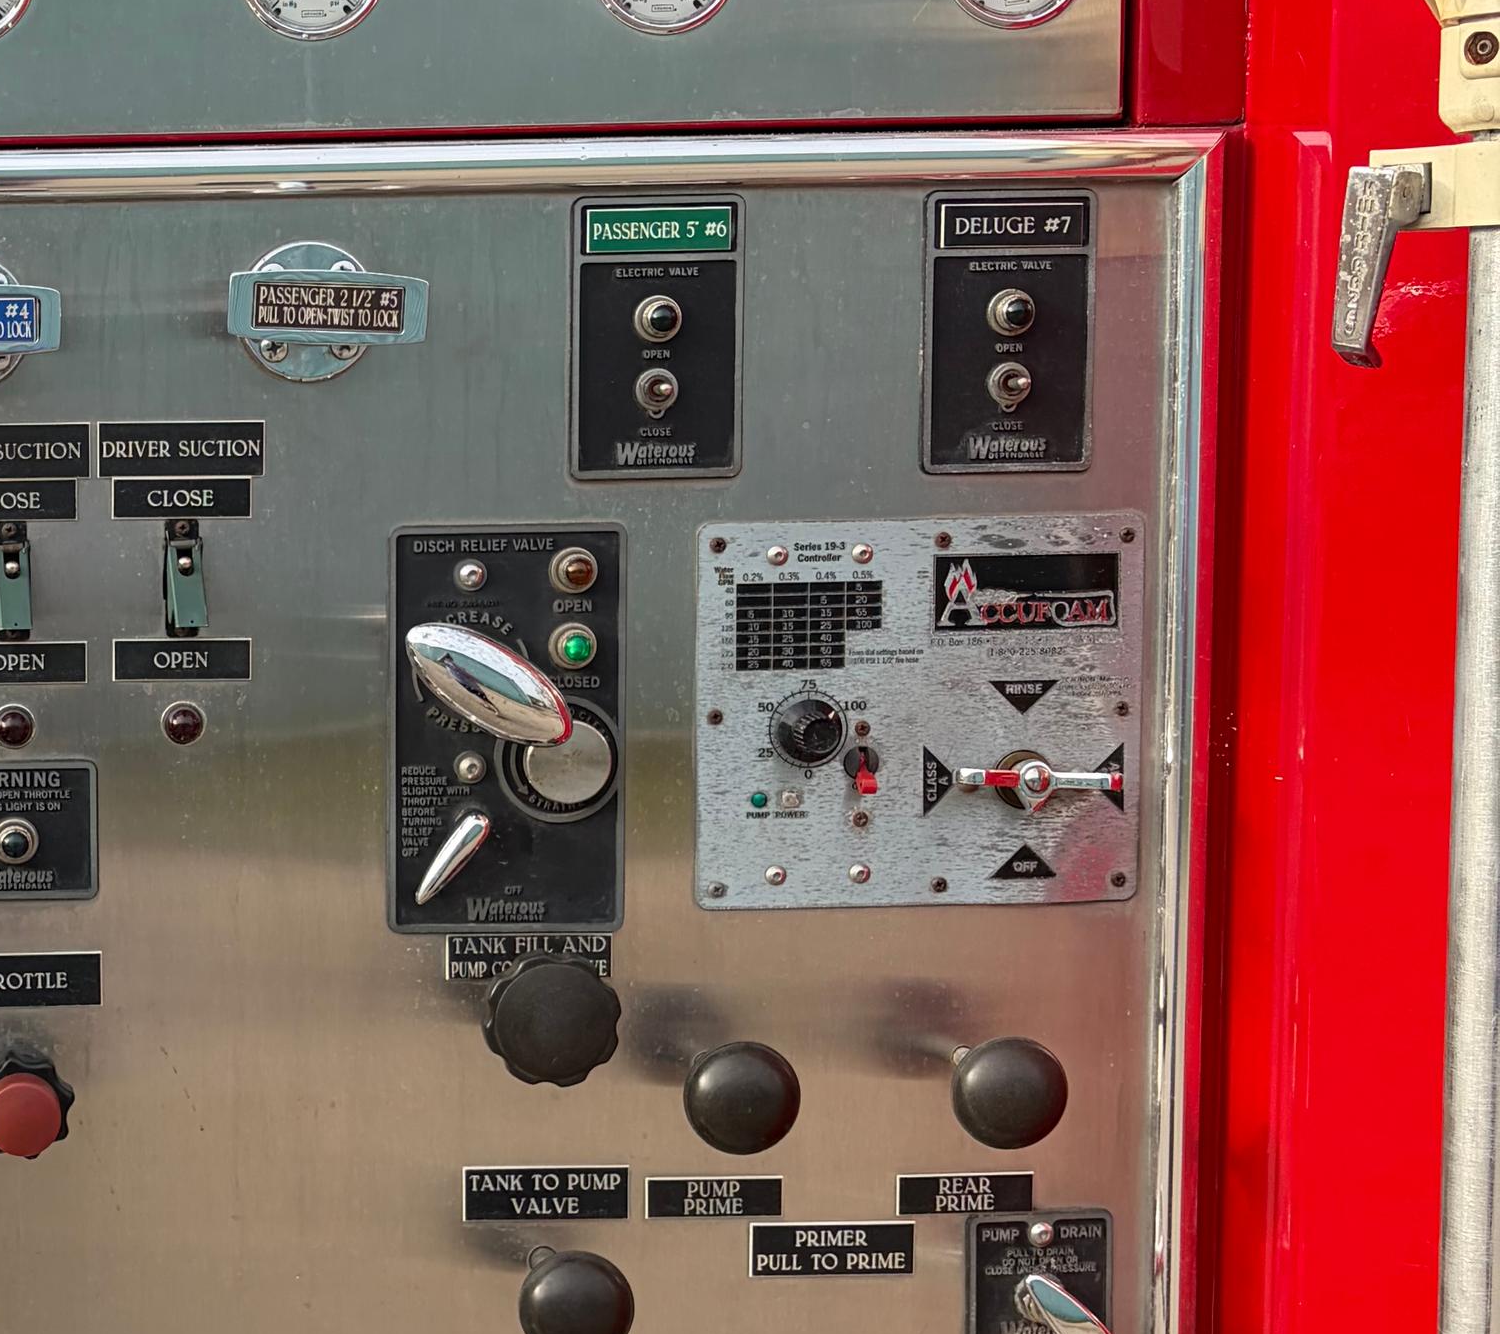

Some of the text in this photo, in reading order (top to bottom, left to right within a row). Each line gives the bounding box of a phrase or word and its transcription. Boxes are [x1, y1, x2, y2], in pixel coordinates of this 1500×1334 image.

[593, 220, 681, 240] PASSENGER
[705, 219, 727, 237] #6
[954, 215, 1071, 235] DELUGE #7
[616, 267, 699, 278] ELECTRIC VALVE
[5, 303, 30, 320] #4
[7, 322, 32, 339] LOCK
[643, 349, 670, 359] OPEN
[102, 439, 261, 459] DRIVER SUCTION
[413, 537, 555, 553] DISCH RELIEF VALVE
[794, 542, 845, 551] Series 19-3
[798, 554, 842, 562] Controller
[553, 599, 593, 613] OPEN
[153, 652, 208, 669] OPEN
[1006, 684, 1043, 694] RINSE
[843, 699, 867, 712] 100
[470, 1174, 621, 1191] TANK TO PUMP
[687, 1182, 740, 1198] PUMP
[511, 1196, 579, 1214] VALVE
[683, 1198, 743, 1215] PRIME
[795, 1230, 868, 1247] PRIMER
[757, 1252, 905, 1271] PULL TO PRIME
